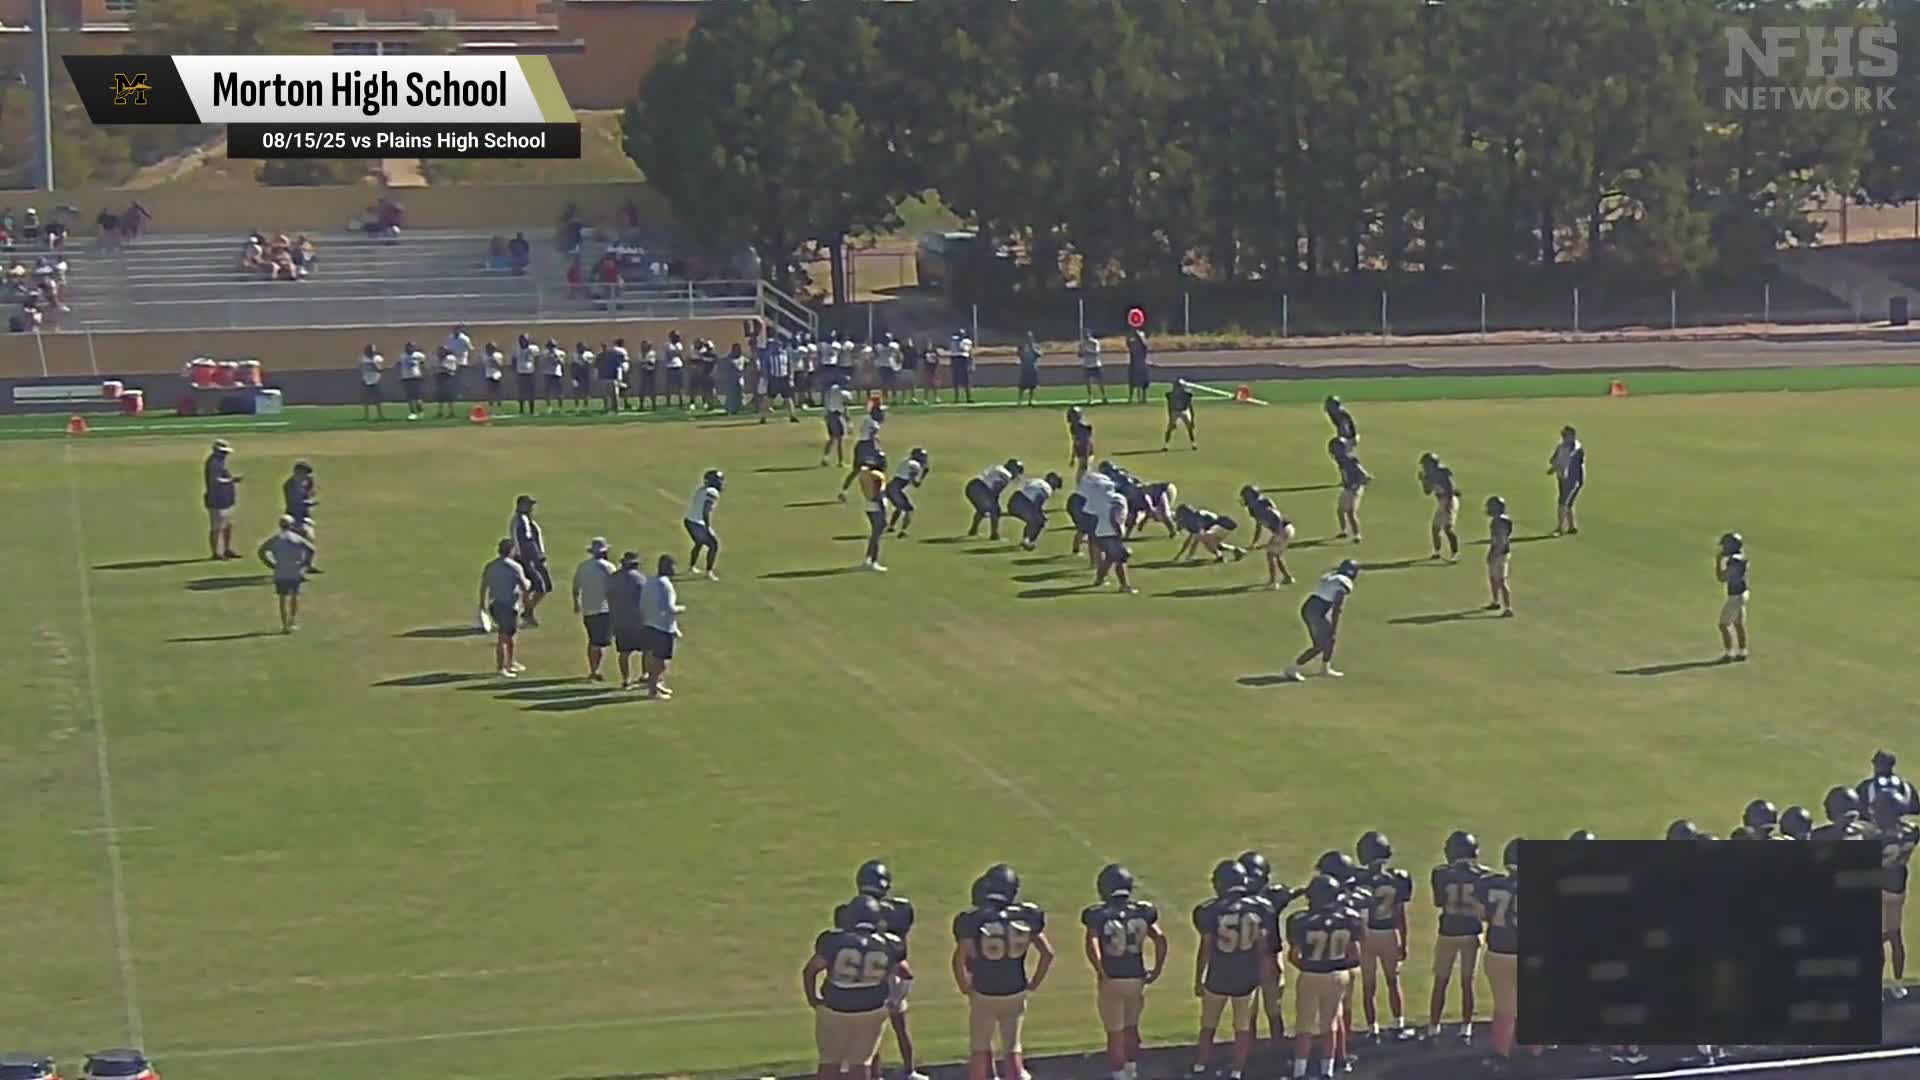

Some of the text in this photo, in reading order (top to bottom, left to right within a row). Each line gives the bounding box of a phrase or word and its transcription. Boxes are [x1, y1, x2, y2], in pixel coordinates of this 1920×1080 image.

[1487, 888, 1518, 928] 7
[1216, 911, 1263, 953] 50
[1306, 930, 1351, 961] 70
